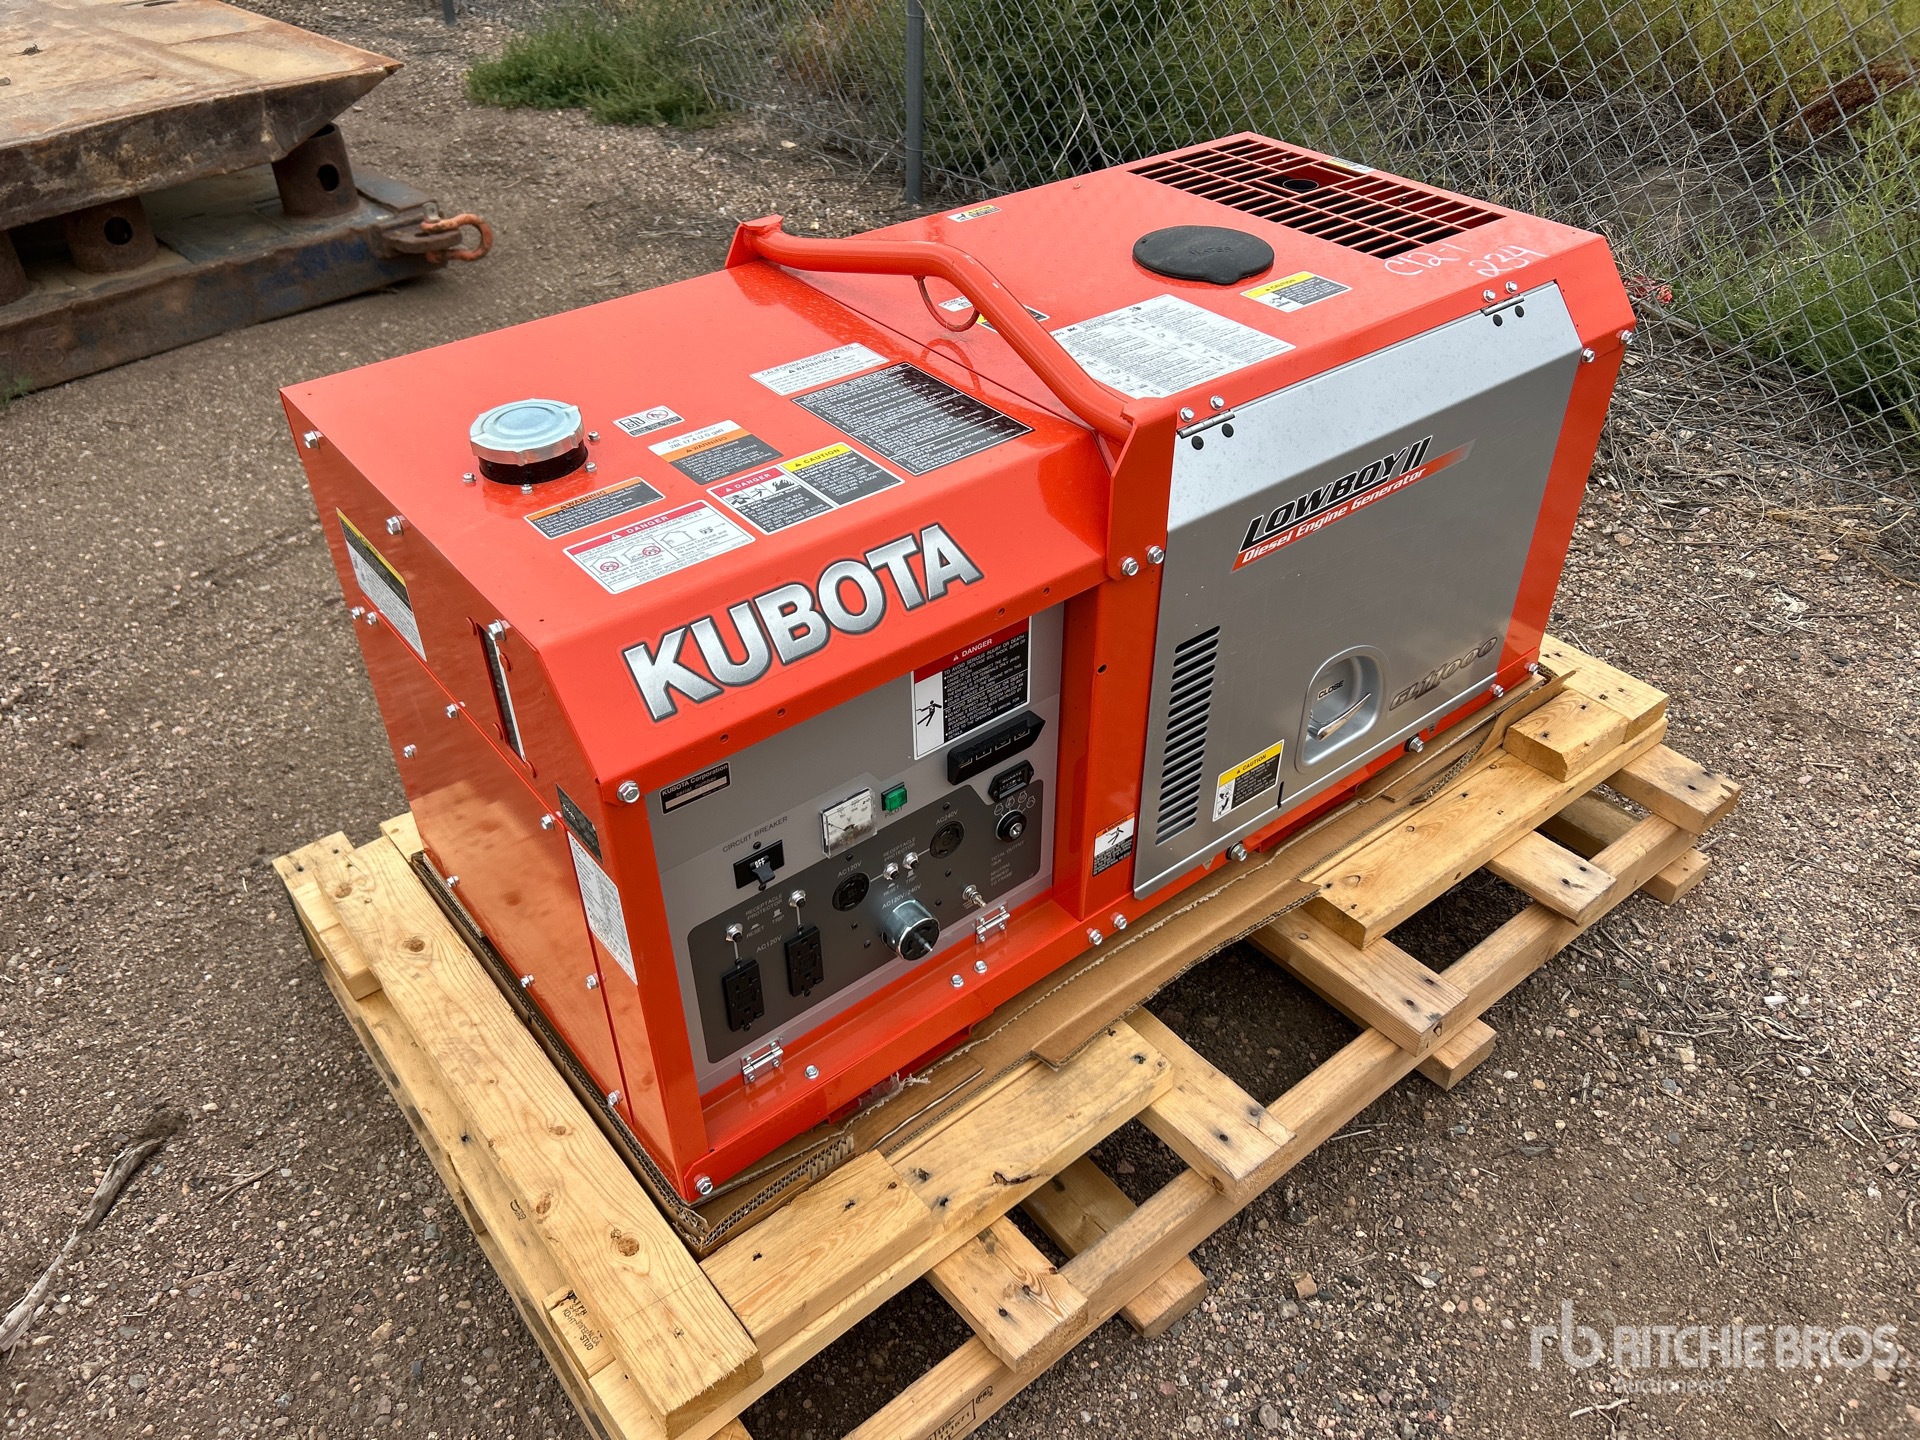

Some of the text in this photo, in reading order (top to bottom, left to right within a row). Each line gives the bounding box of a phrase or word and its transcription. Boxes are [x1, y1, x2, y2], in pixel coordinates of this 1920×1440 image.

[1468, 245, 1549, 278] 234
[803, 449, 841, 464] CAUTION
[735, 473, 772, 489] DANGER
[567, 490, 608, 508] WARNING
[1238, 434, 1433, 554] LOWBOY II
[626, 516, 670, 534] DANGER
[1241, 467, 1427, 564] Diesel Engine Generator
[622, 522, 985, 723] KUBOTA
[962, 638, 992, 658] DANGER
[1318, 680, 1344, 699] CLOSE
[1242, 753, 1266, 771] CAUTION
[662, 780, 690, 796] KUBOTA
[690, 764, 728, 784] Corporation
[936, 810, 959, 825] AC240V
[722, 815, 789, 853] CIRCUIT BREAKER
[883, 837, 916, 858] RECEPTACLE
[884, 843, 916, 862] PROTECTOR
[837, 860, 862, 878] AC120V
[745, 893, 783, 916] RECEPTACLE
[882, 883, 922, 910] AC120V/240V
[747, 899, 784, 921] PROTECTOR
[746, 925, 765, 938] RESET
[756, 935, 783, 953] AC120V
[580, 1334, 594, 1351] STUD
